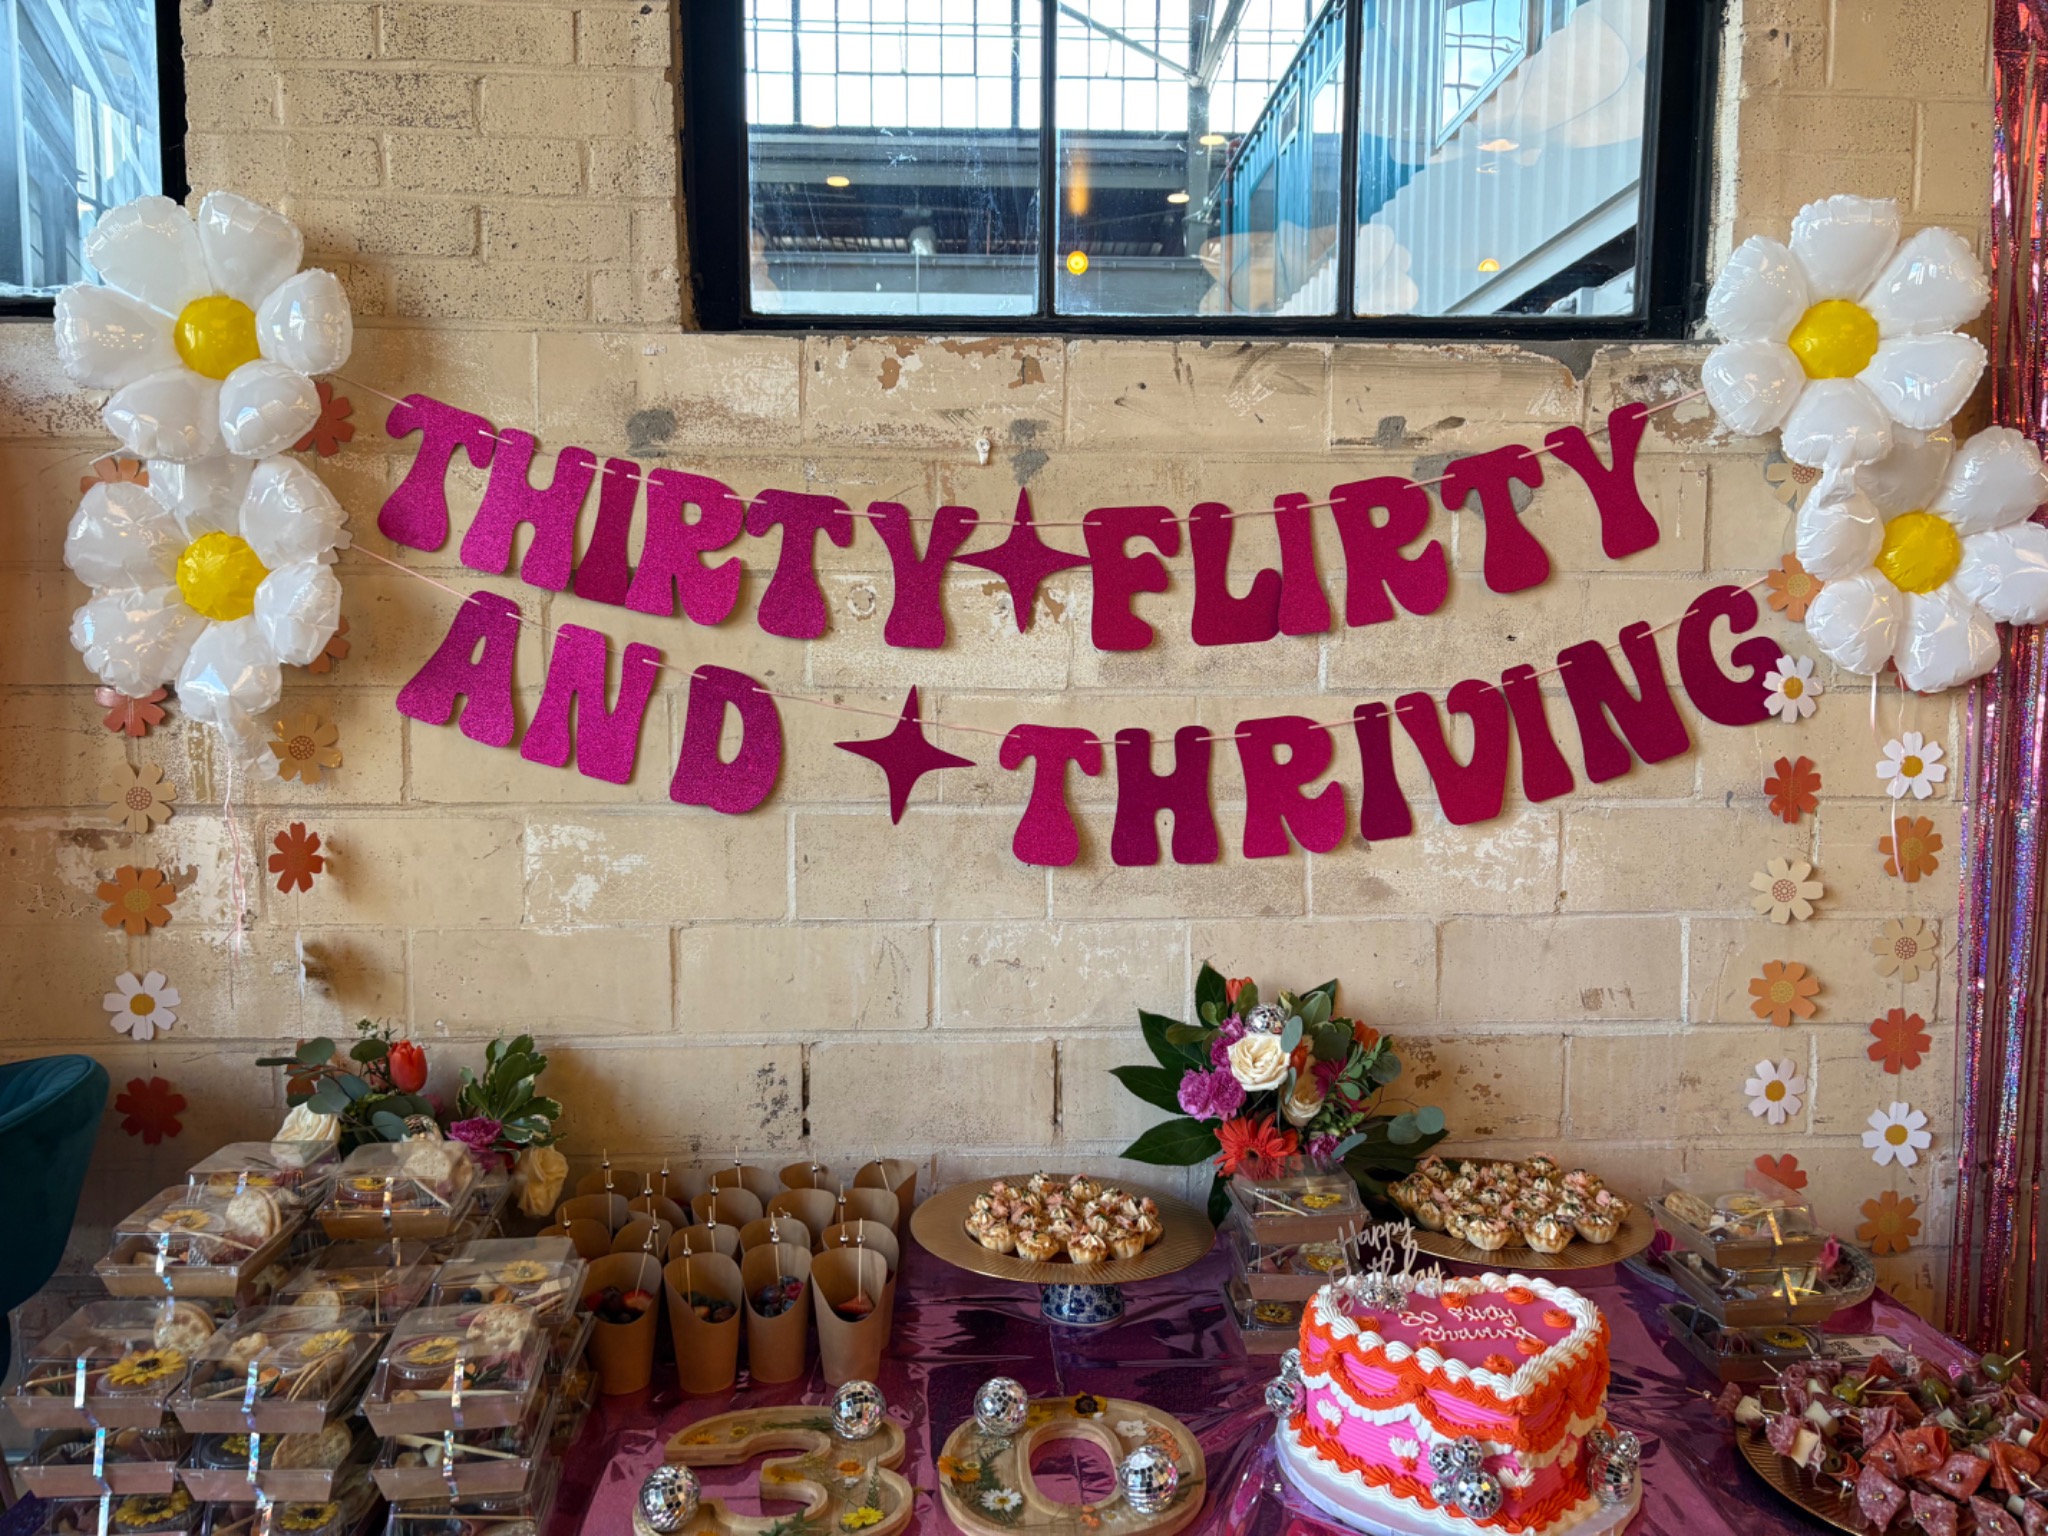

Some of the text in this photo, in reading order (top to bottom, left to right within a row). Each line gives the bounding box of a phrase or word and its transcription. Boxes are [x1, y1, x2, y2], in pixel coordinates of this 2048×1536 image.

[377, 394, 1660, 651] THIRTY FLIRTY
[396, 585, 1784, 867] AND THRIVING
[1328, 1240, 1447, 1314] Bthday
[1332, 1217, 1417, 1266] Happy
[1398, 1311, 1438, 1327] 30
